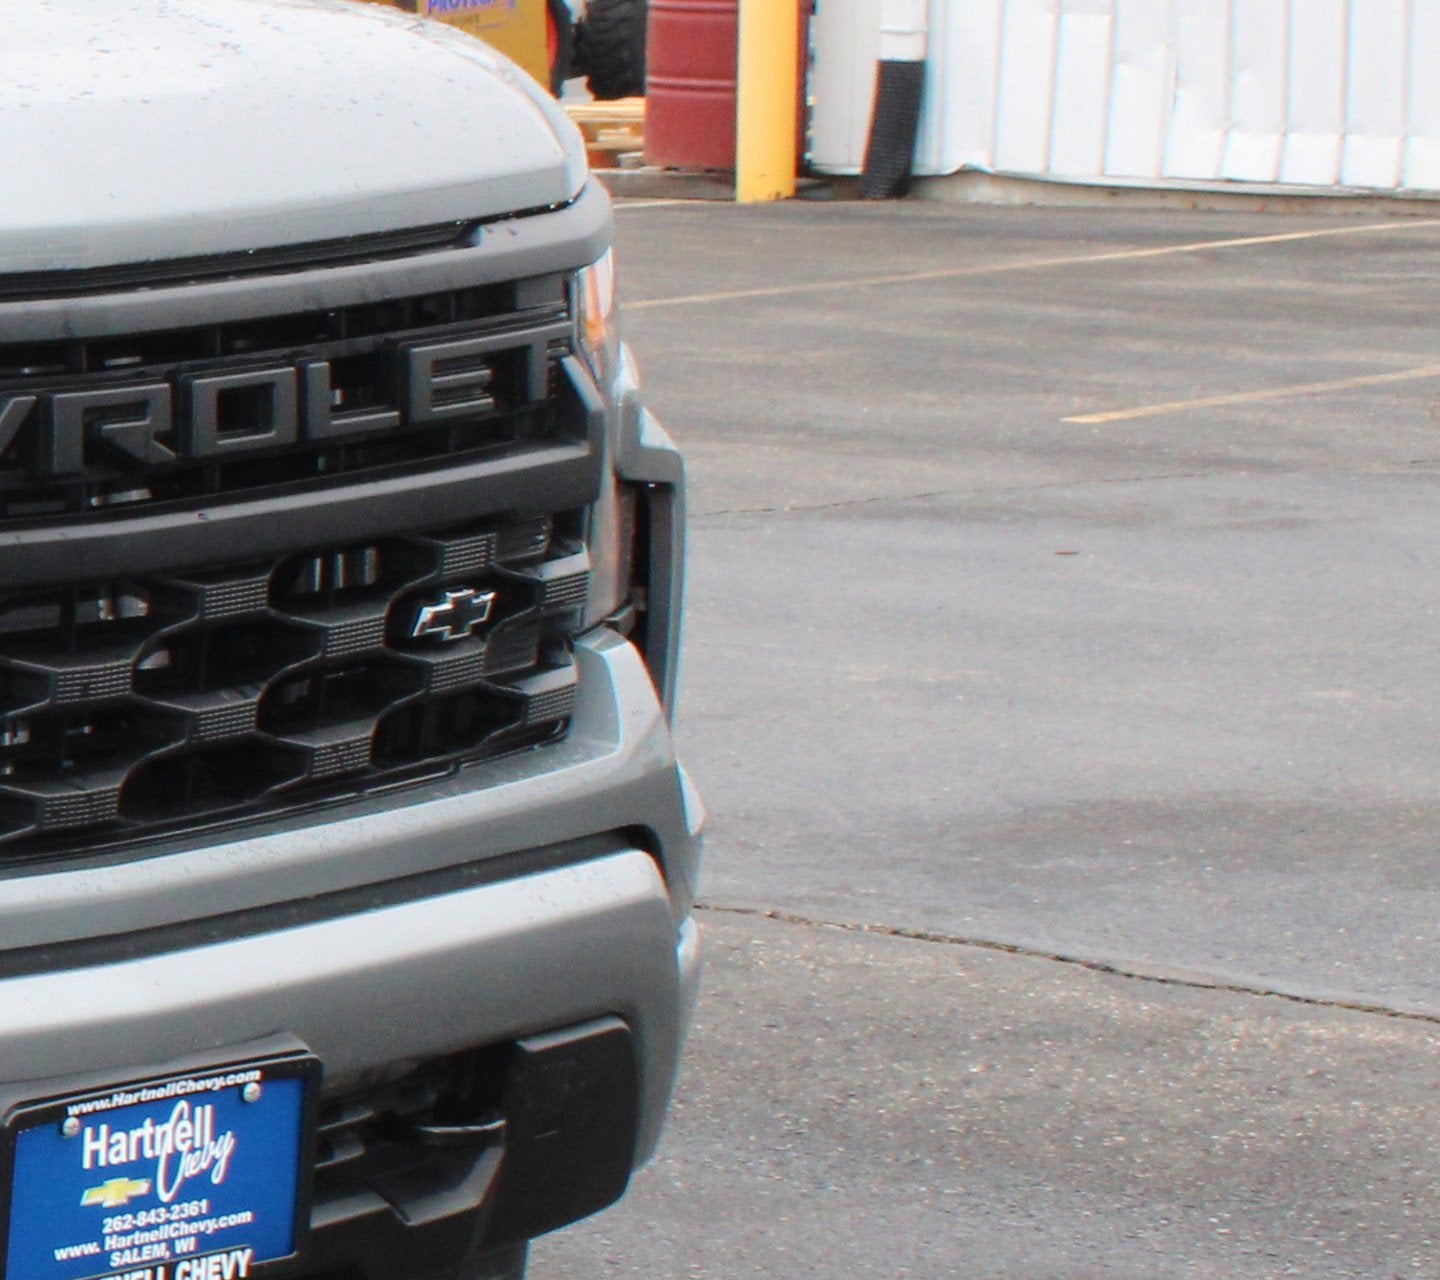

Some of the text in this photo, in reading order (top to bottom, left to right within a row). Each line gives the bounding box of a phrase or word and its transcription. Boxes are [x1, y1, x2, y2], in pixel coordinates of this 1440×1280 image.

[66, 1069, 263, 1117] www.HartnellChevy.com
[82, 1104, 214, 1170] Hartnell
[156, 1099, 236, 1203] Chevy
[101, 1198, 211, 1235] 262-843-2361
[104, 1211, 255, 1252] HartnellChevy.com
[109, 1237, 198, 1268] SALEM, WI
